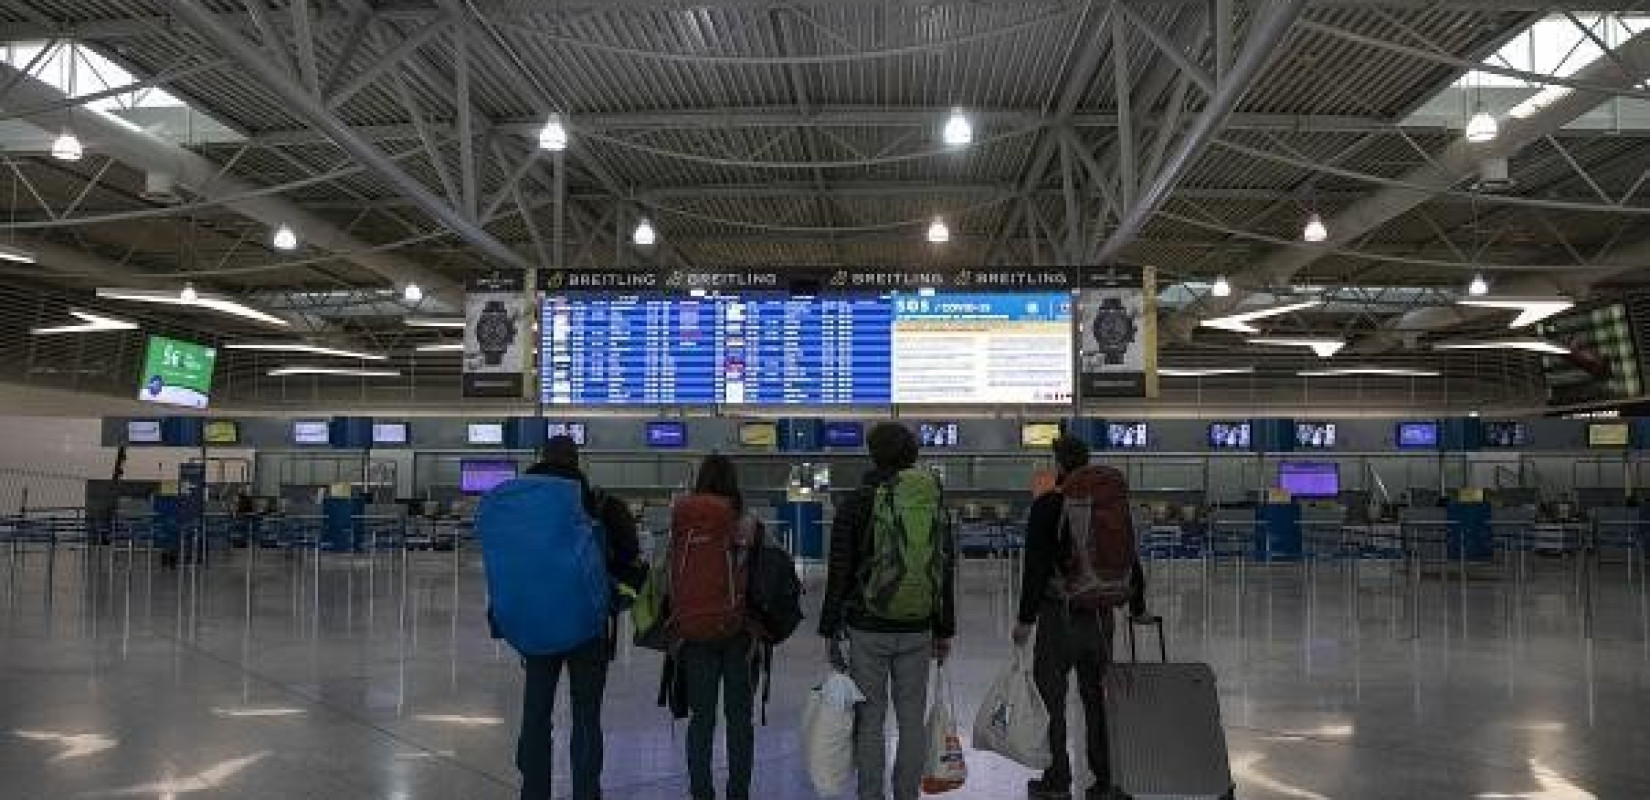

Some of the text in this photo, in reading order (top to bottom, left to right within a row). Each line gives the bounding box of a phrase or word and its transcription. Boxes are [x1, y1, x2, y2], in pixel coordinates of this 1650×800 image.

[569, 273, 656, 286] BREITLING
[687, 273, 777, 286] BREITLING
[851, 273, 944, 284] BREITLING
[975, 273, 1067, 284] BREITLING
